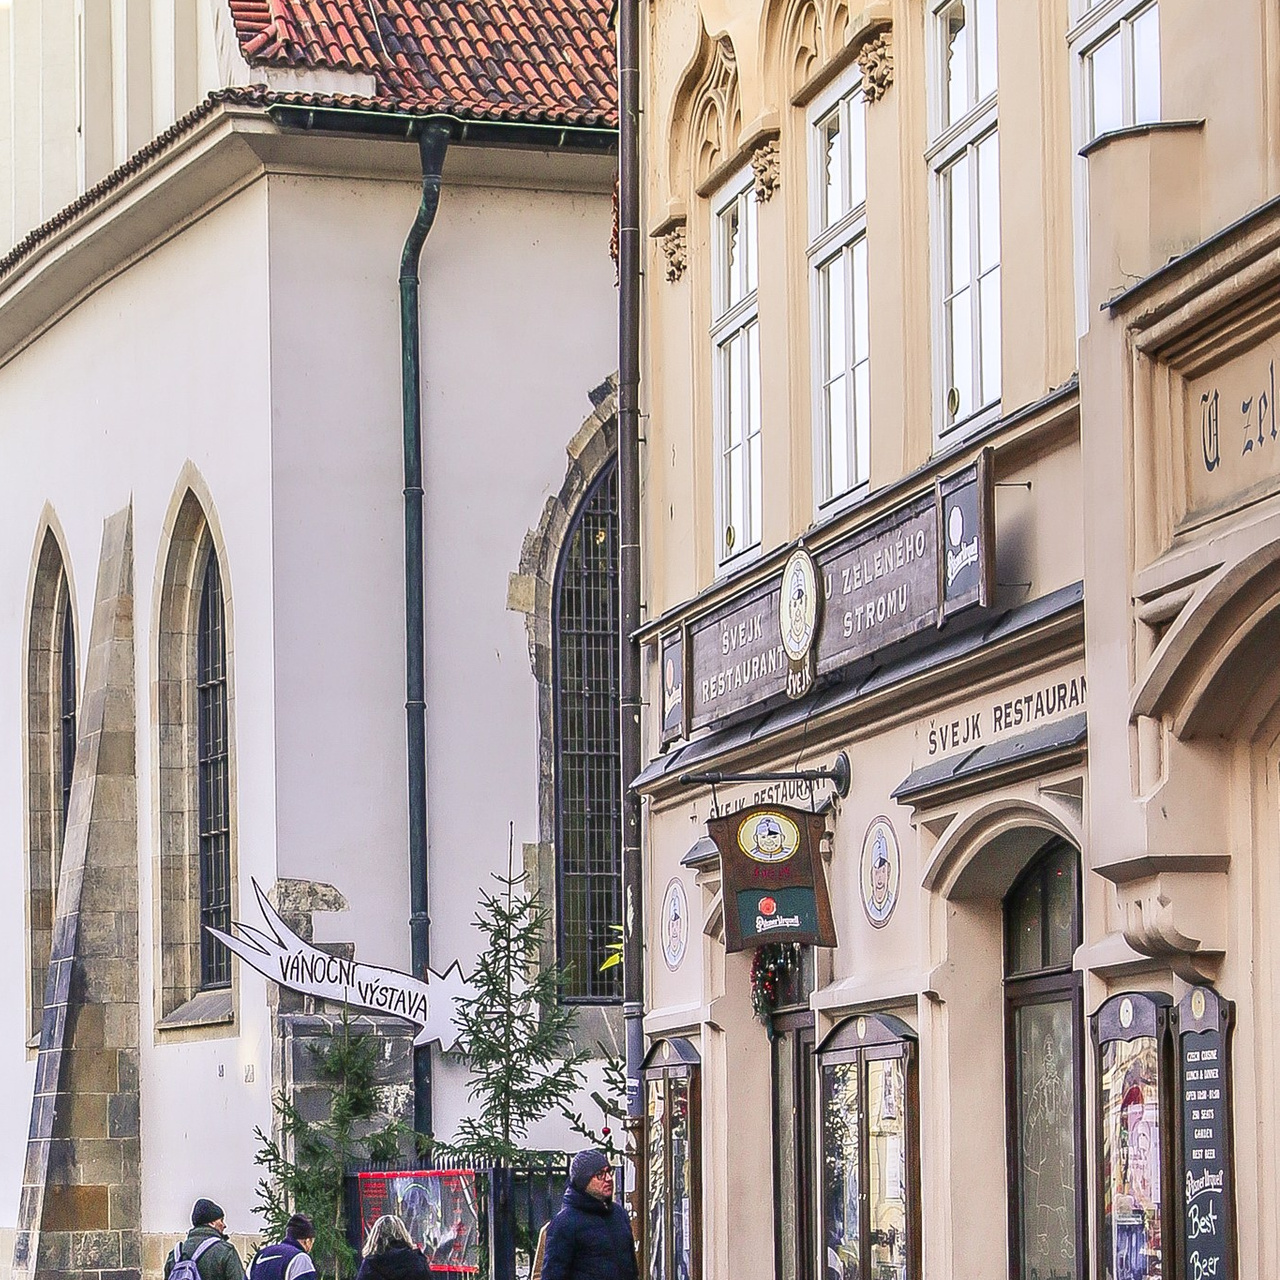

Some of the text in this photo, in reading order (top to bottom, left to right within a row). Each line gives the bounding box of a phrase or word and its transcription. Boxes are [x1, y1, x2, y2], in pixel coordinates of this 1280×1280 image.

[823, 529, 926, 600] U ZELENÉHO
[722, 613, 763, 656] ŠVEJK
[843, 583, 909, 639] STROMU
[701, 645, 785, 704] RESTAURANT
[928, 712, 981, 755] ŠVEJK
[279, 949, 429, 1022] VÁNOČNÍ VÝSTAVA
[1188, 1199, 1218, 1239] Best
